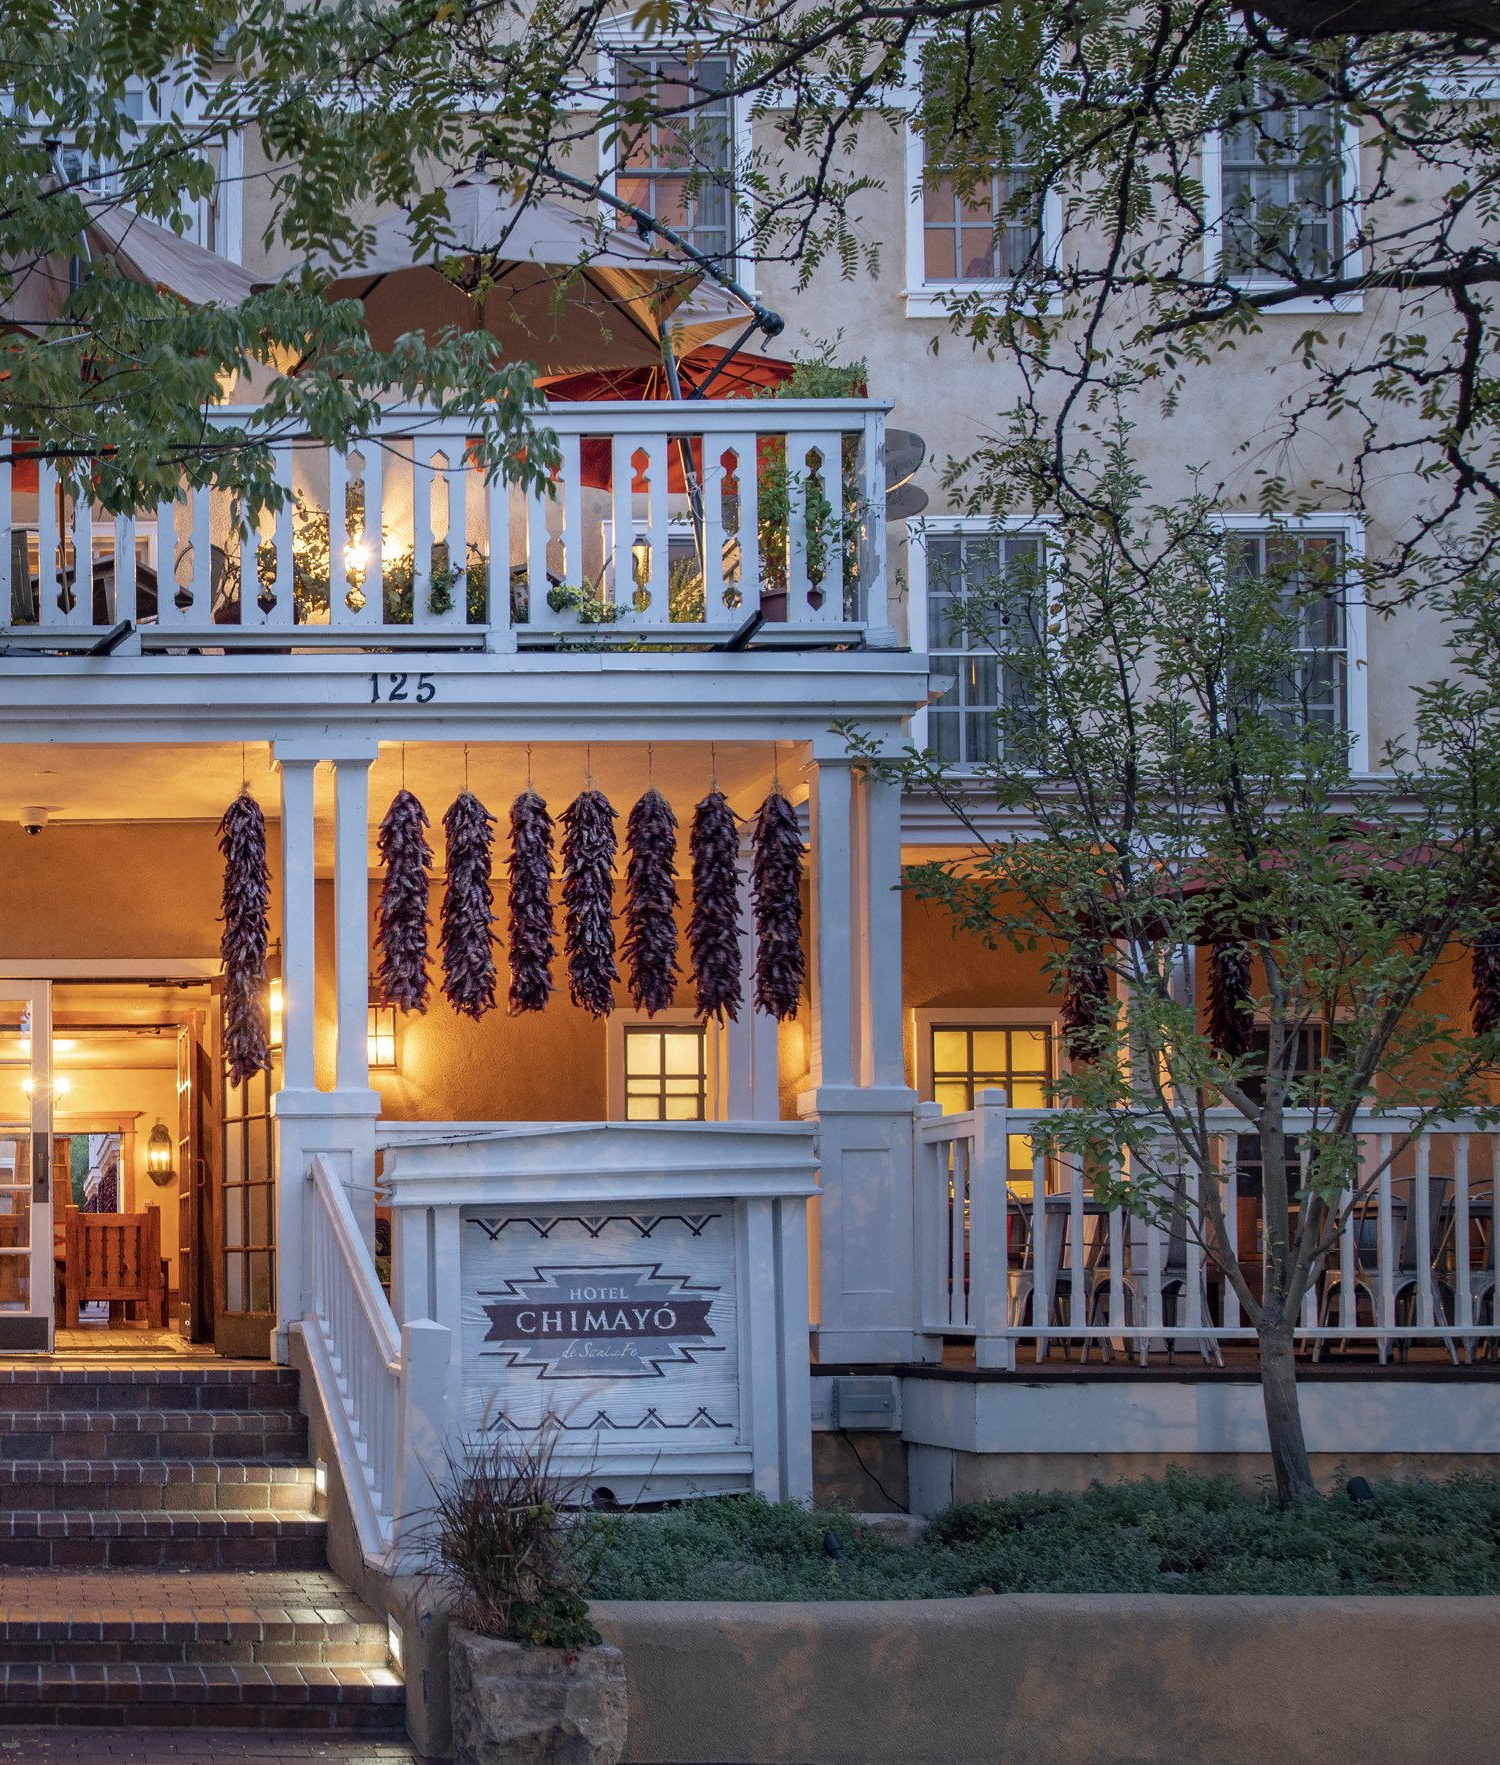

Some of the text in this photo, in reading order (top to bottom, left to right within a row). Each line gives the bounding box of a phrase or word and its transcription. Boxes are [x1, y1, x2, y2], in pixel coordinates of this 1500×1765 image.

[368, 672, 436, 703] 125
[570, 1287, 629, 1301] HOTEL
[516, 1302, 677, 1333] CHIMAYÓ
[562, 1338, 579, 1359] de
[621, 1341, 638, 1358] Fe
